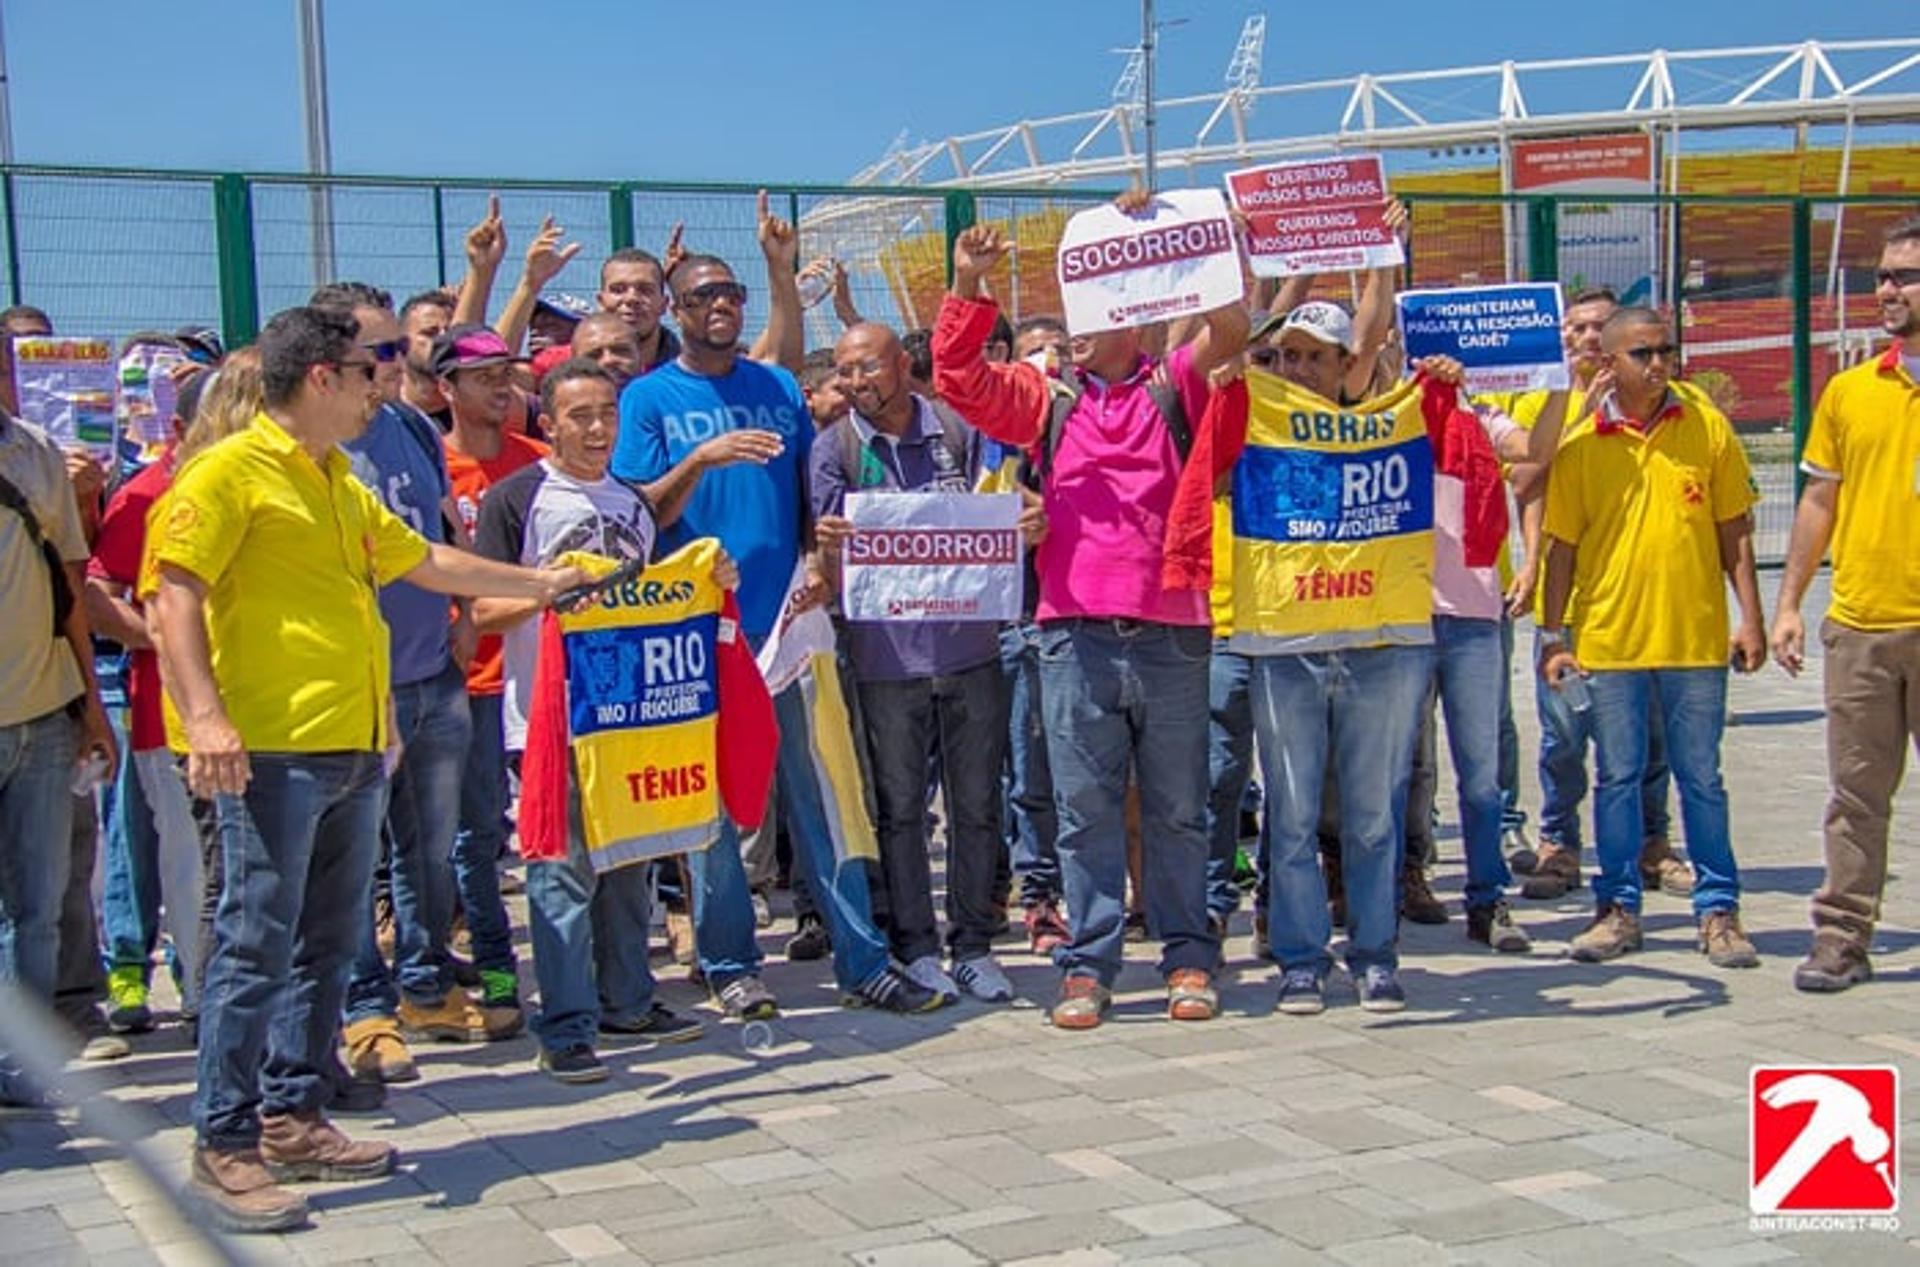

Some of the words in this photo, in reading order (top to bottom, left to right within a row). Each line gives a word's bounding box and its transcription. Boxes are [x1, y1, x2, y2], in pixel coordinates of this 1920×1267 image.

[1266, 164, 1348, 187] QUEREMOS
[1240, 189, 1301, 206] NOSSOS
[1275, 211, 1357, 233] QUEREMOS
[1065, 221, 1229, 276] SOCORRO!!
[1253, 236, 1315, 252] NOSSOS
[1425, 299, 1536, 316] PROMETERAM
[1407, 320, 1460, 334] PAGAR
[1462, 321, 1474, 332] A
[1458, 332, 1510, 348] CADÊ?
[663, 404, 799, 445] ADIDAS
[1290, 411, 1395, 442] OBRAS
[1342, 454, 1409, 506] RIO
[1288, 521, 1325, 537] SMO
[852, 534, 1013, 558] SOCORRO!!
[1295, 567, 1374, 601] TÊNIS
[643, 631, 706, 685] RIO
[627, 765, 707, 803] TÊNIS
